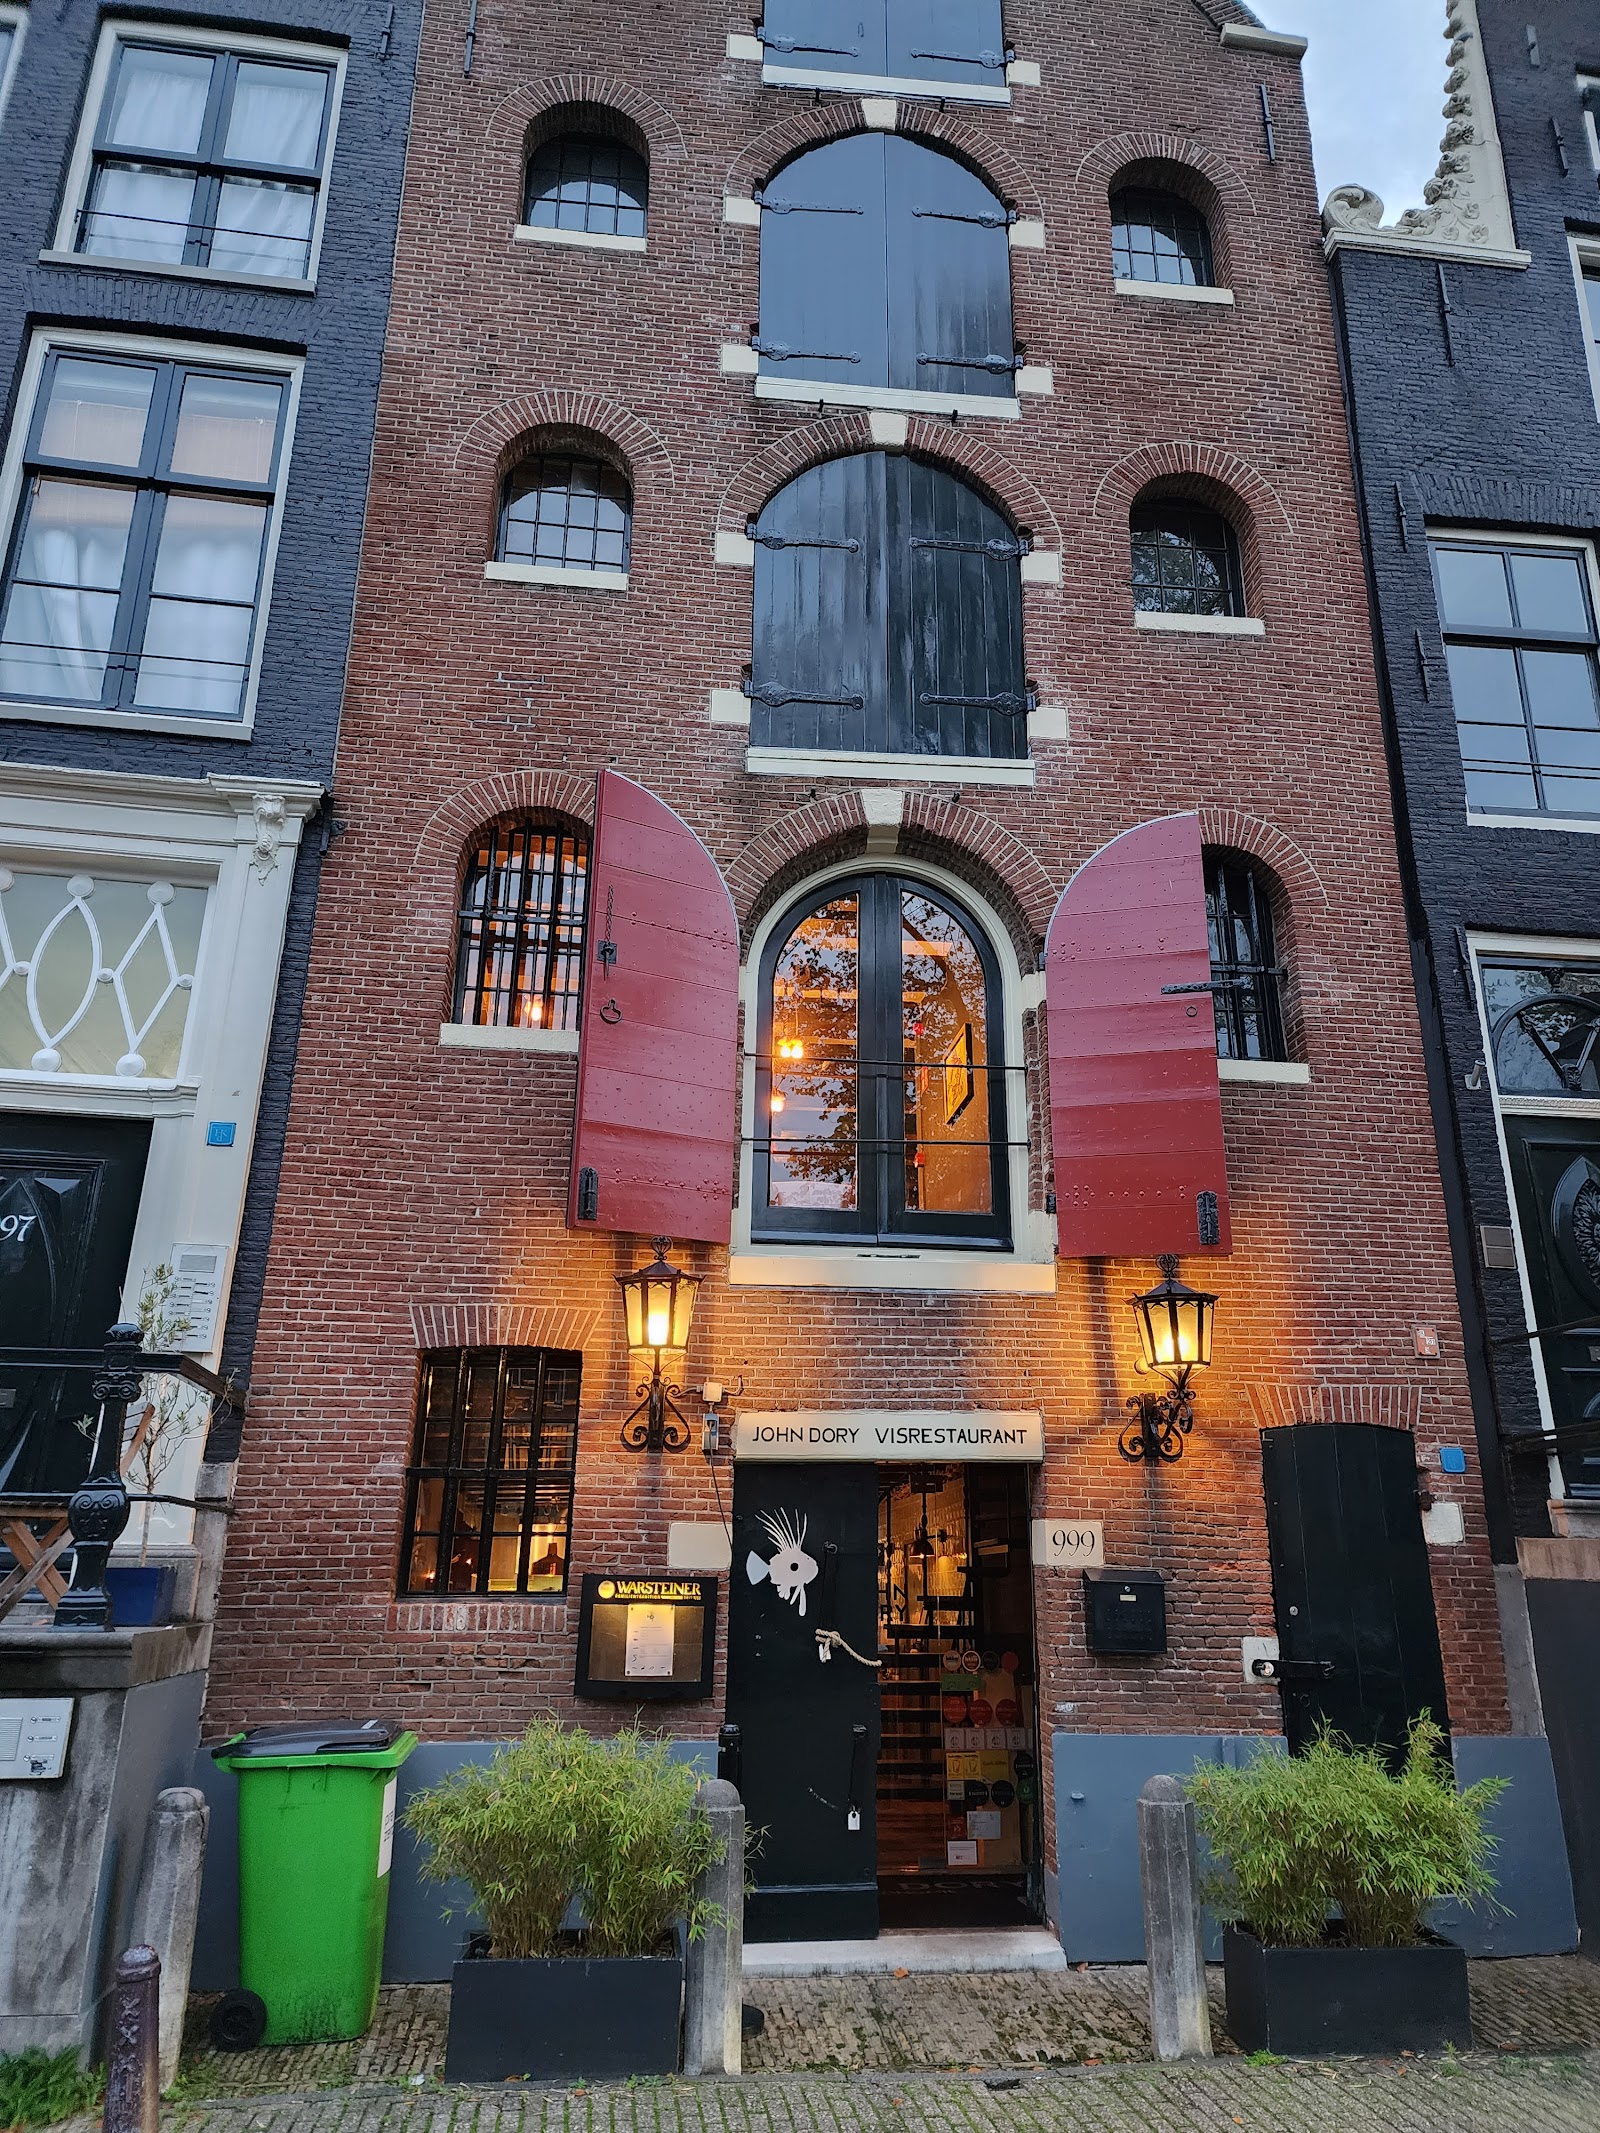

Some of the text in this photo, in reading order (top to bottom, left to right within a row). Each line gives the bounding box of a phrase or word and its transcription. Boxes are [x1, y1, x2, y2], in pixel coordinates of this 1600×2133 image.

[0, 1214, 37, 1242] 97
[752, 1426, 1028, 1445] JOHN DORY VISRESTAURANT
[1052, 1529, 1095, 1557] 999
[616, 1580, 702, 1596] WARSTEINER
